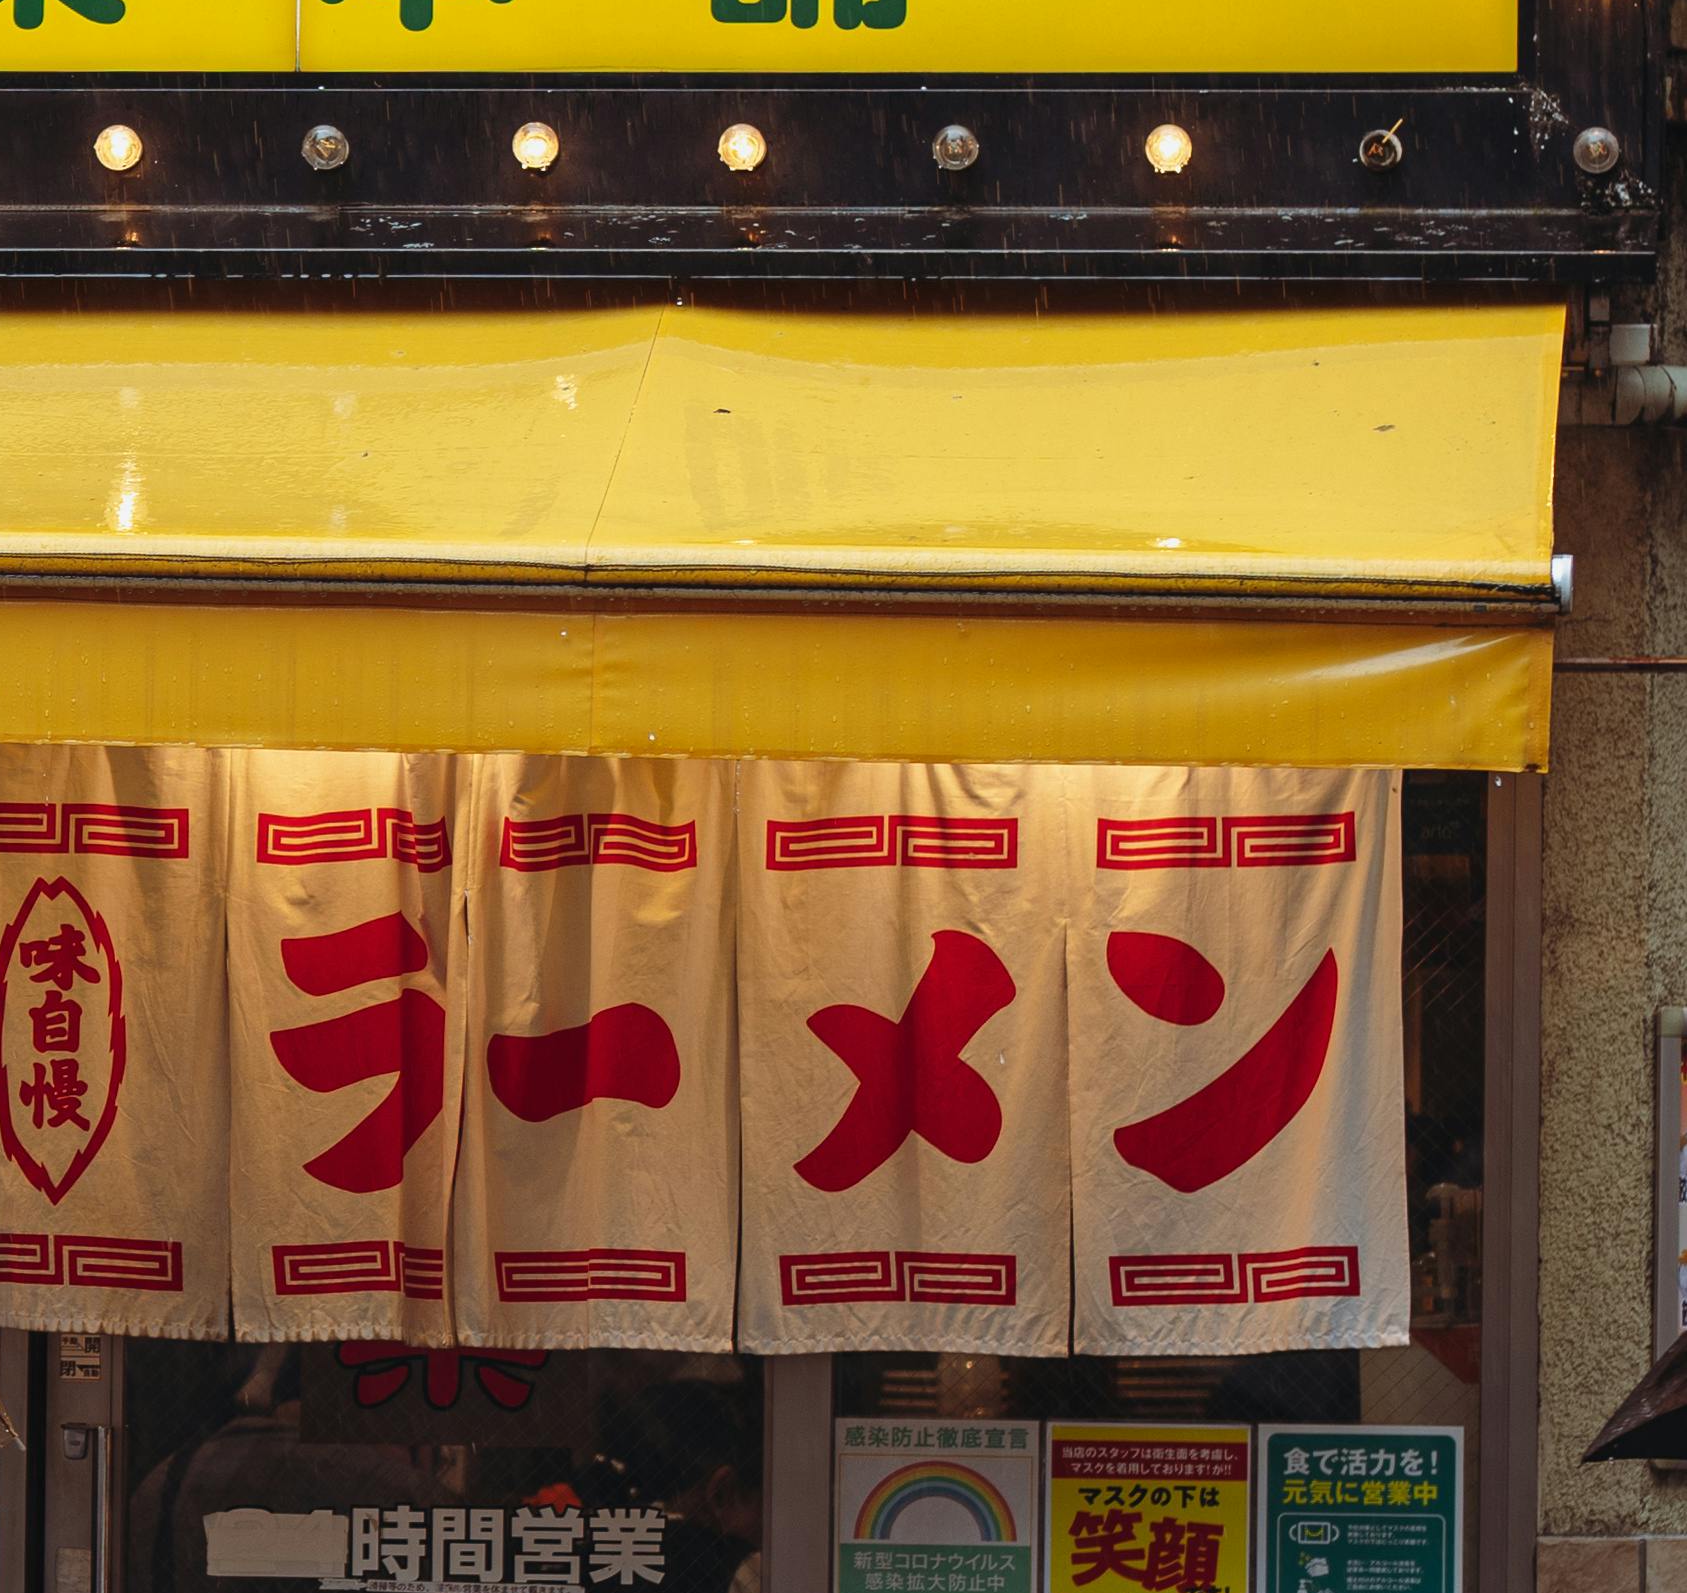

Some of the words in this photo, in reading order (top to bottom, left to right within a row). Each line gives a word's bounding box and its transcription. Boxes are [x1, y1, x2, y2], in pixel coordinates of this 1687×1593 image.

[18, 922, 103, 1134] 味自慢
[270, 910, 1339, 1194] ラーメン
[844, 1426, 1029, 1450] 感染防止徹底宣言
[1078, 1484, 1221, 1508] マスクの下は
[1282, 1478, 1438, 1507] 元気に営業中
[220, 1504, 667, 1586] 時間営業
[854, 1550, 1016, 1572] 新型コロナウイルス
[864, 1573, 1006, 1593] 感染拡大防止中
